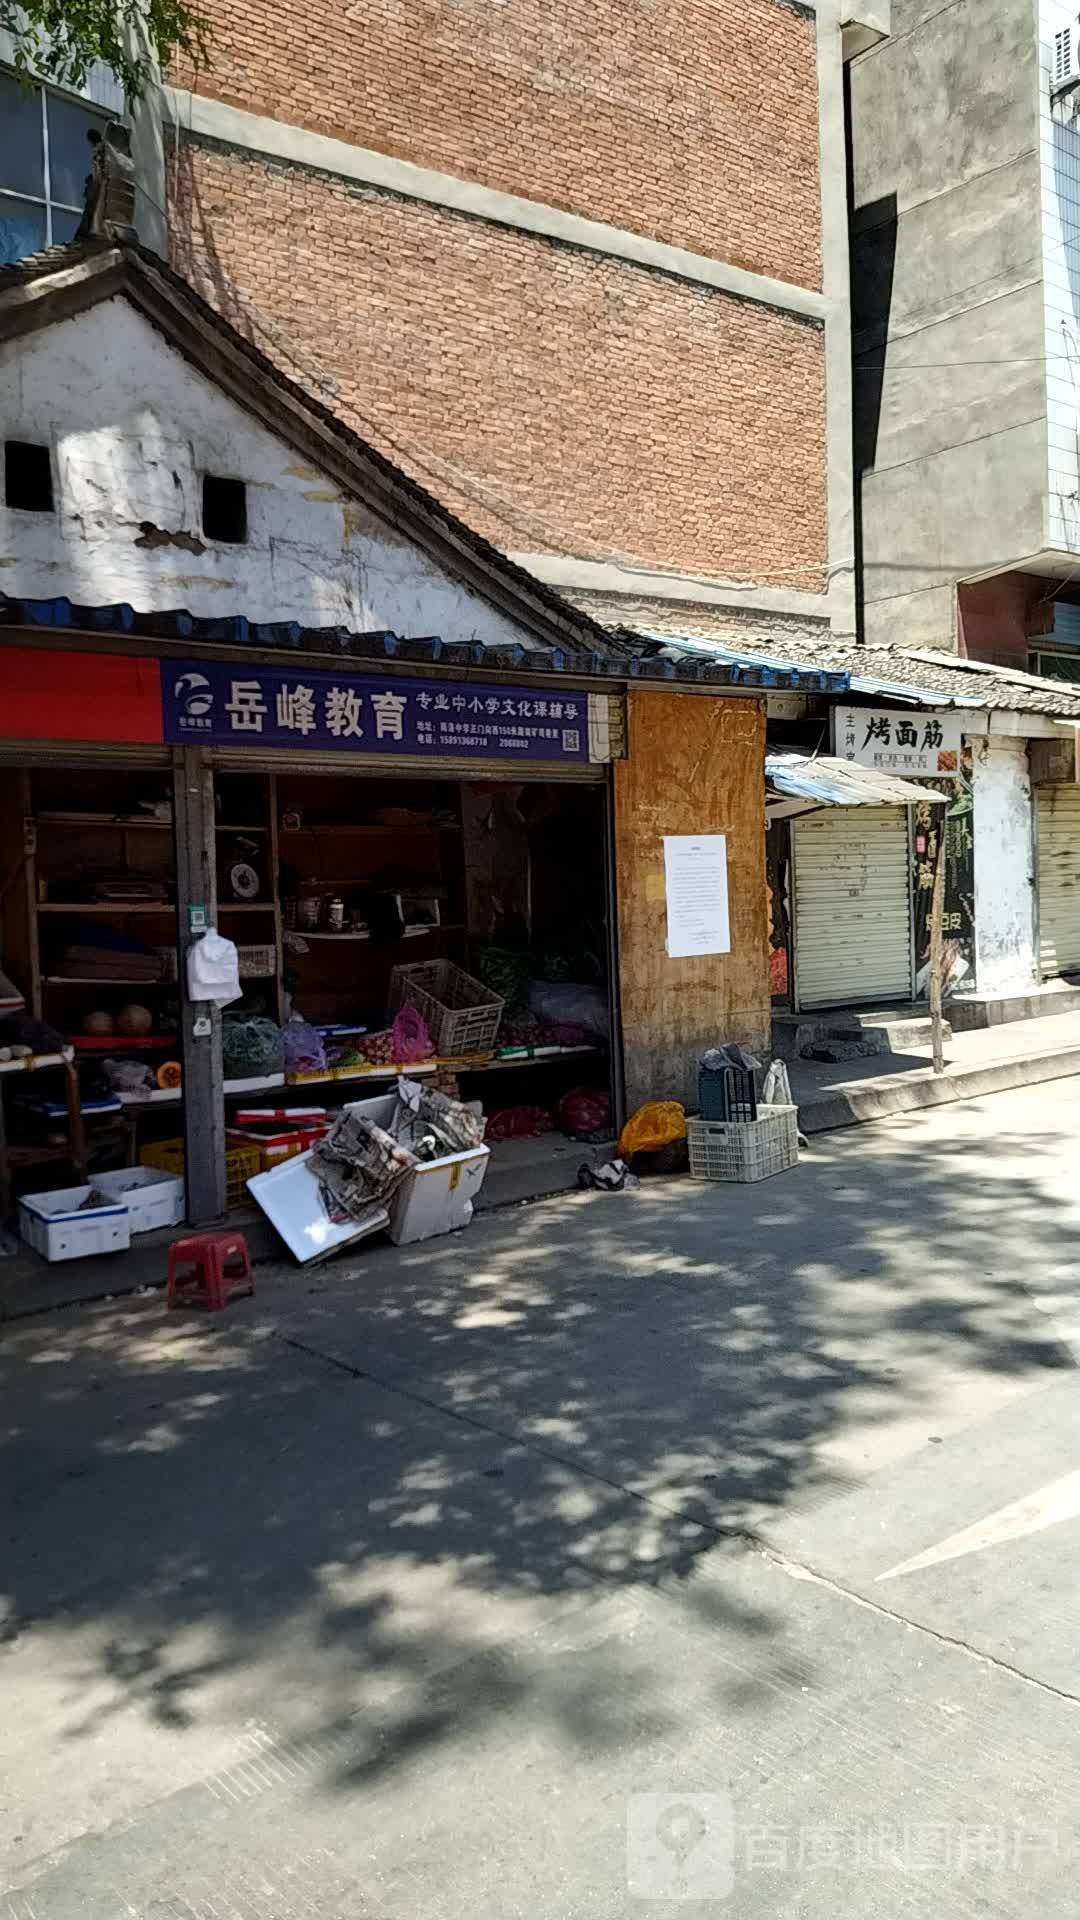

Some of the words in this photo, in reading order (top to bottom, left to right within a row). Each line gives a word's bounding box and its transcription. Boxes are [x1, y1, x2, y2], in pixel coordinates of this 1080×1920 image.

[224, 680, 408, 742] 岳峰教育
[416, 691, 579, 720] 专业中小学文化课辅导
[861, 716, 944, 753] 烤面筋
